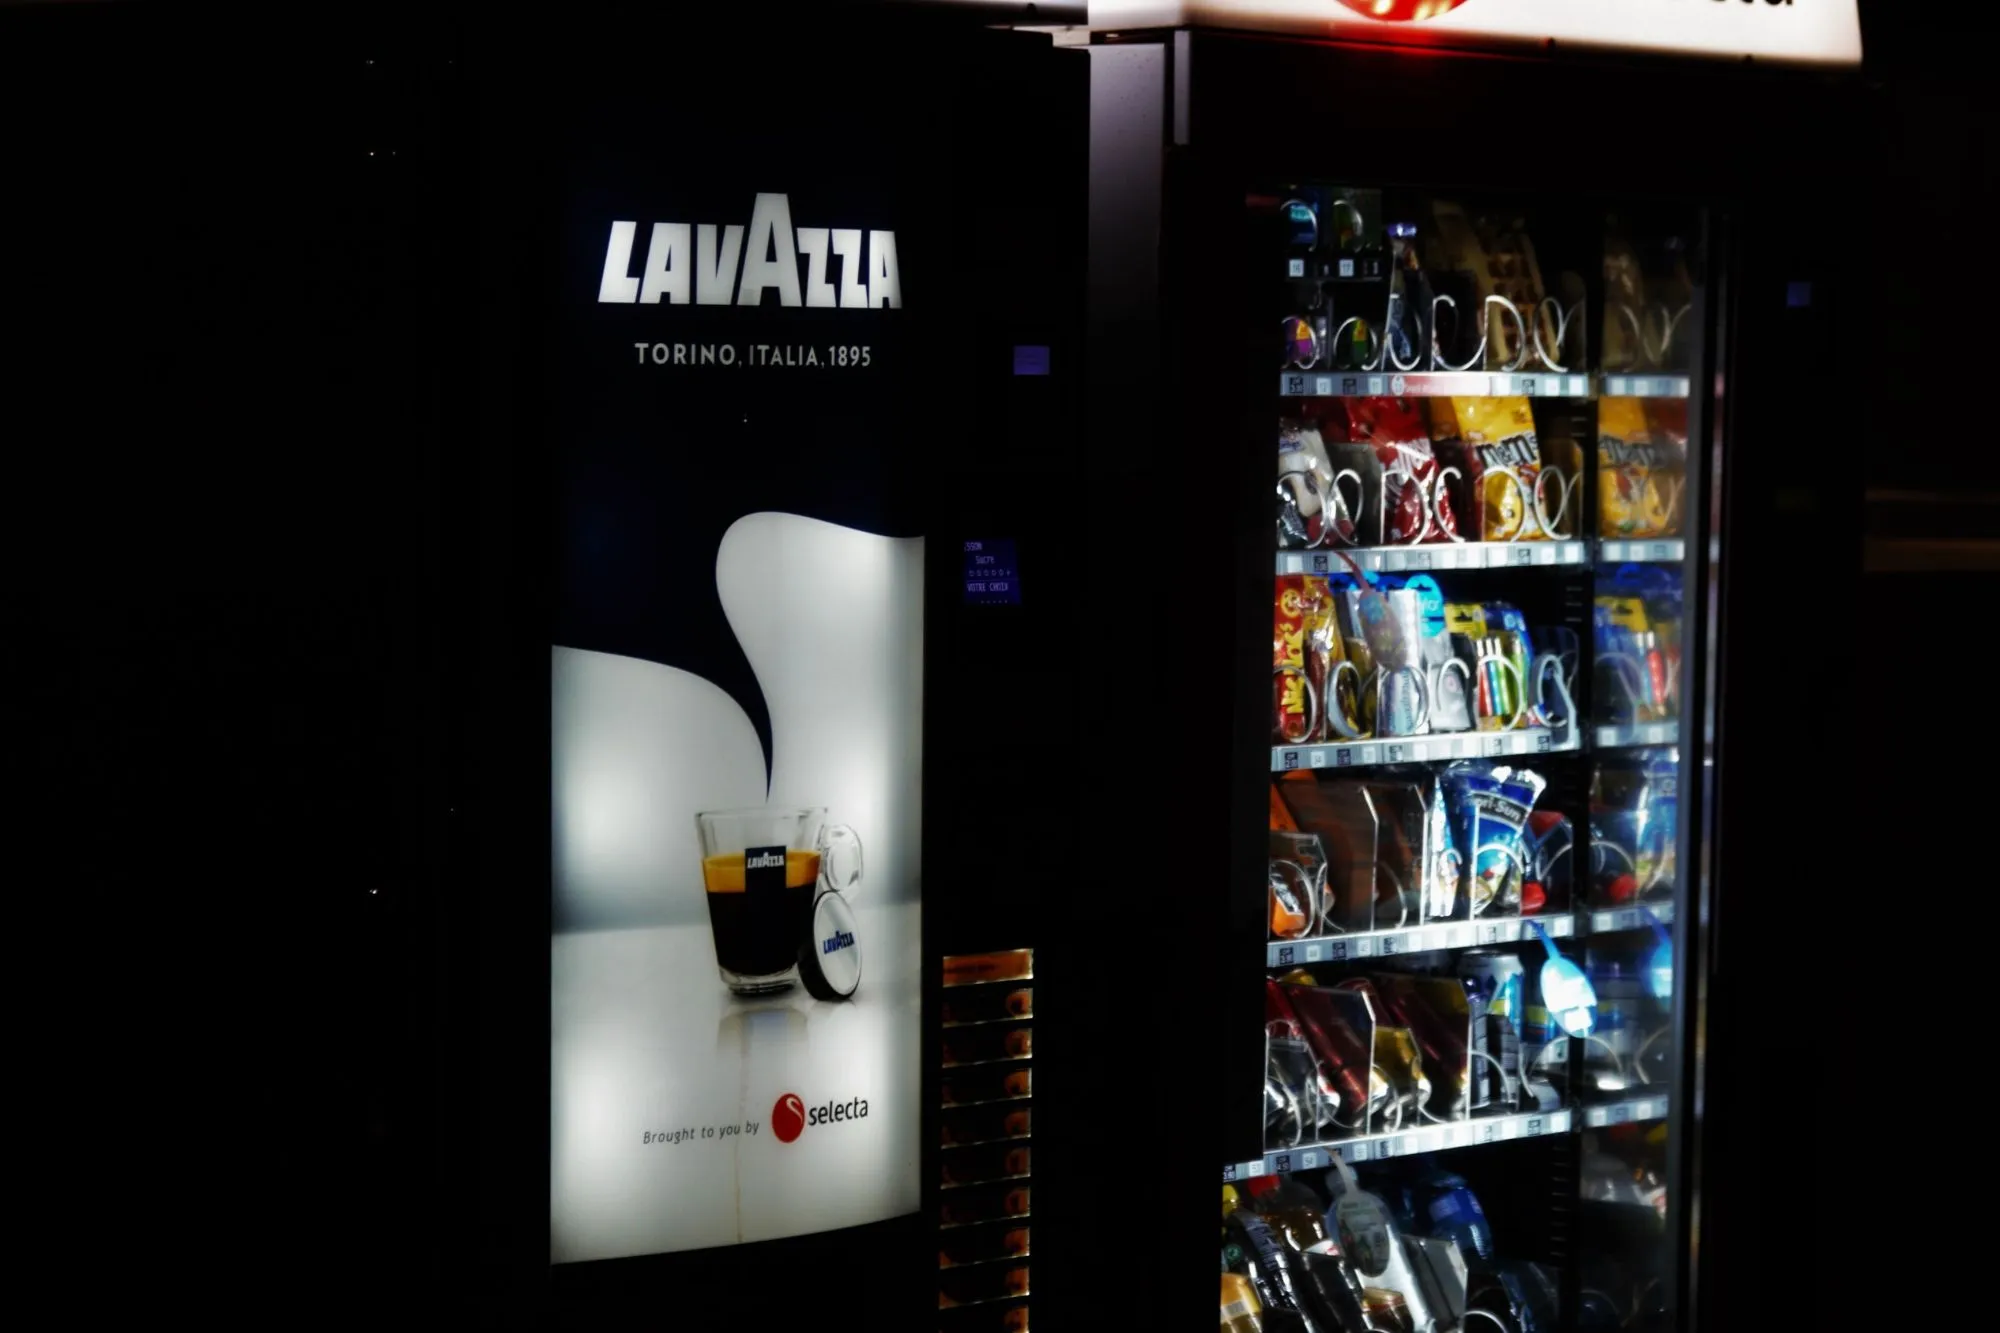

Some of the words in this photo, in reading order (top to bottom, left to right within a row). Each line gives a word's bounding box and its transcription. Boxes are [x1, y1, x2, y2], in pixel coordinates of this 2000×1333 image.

[598, 192, 902, 309] LAVAZZA
[634, 342, 742, 368] TORINO,
[749, 344, 825, 368] ITALIA,
[829, 345, 872, 368] 1895
[747, 852, 784, 869] LAVAZZA
[823, 930, 855, 955] LAVAZZA
[643, 1127, 695, 1144] Brought
[701, 1125, 714, 1139] to
[719, 1123, 741, 1140] you
[745, 1120, 760, 1136] by
[808, 1096, 869, 1127] selecta
